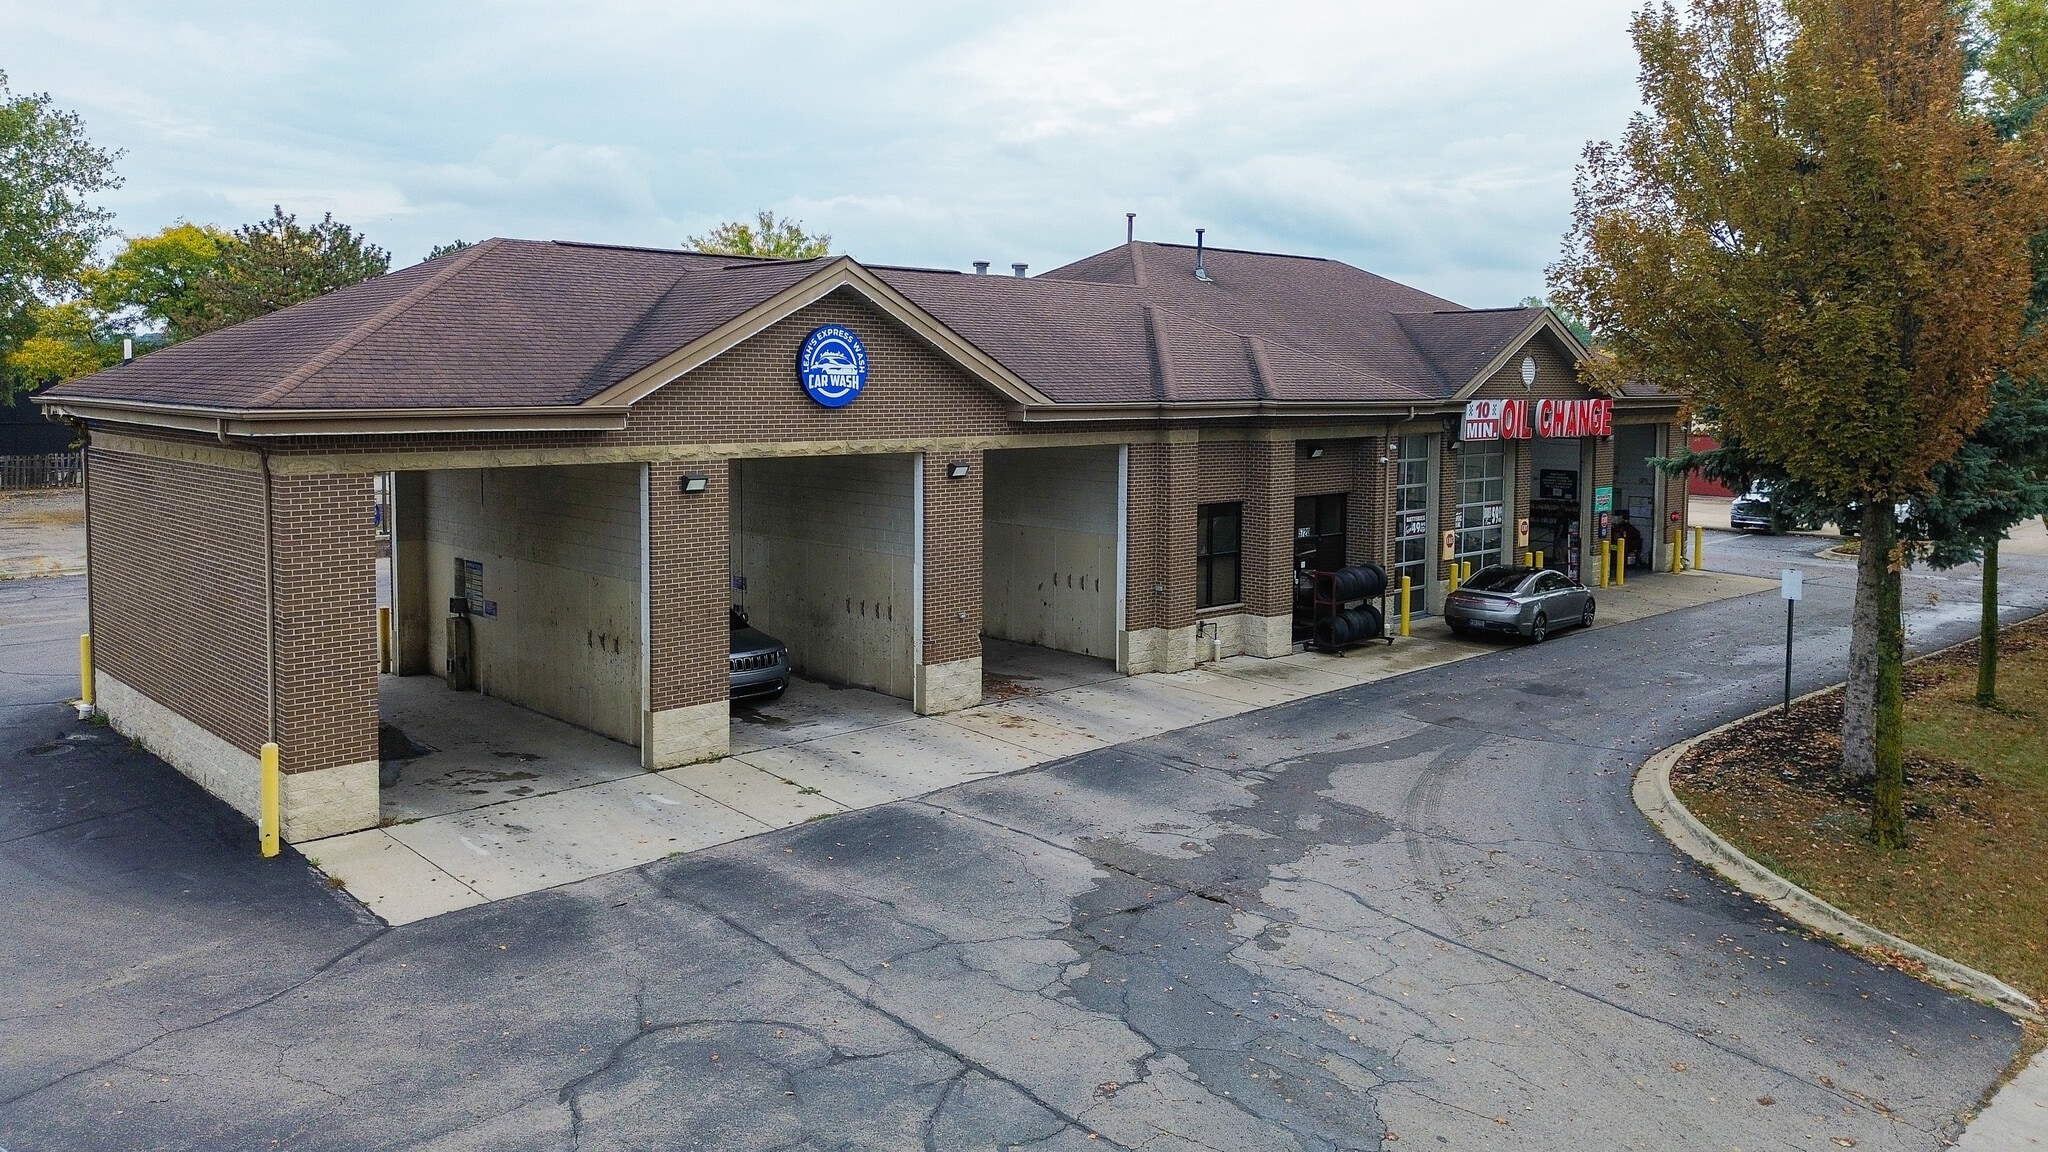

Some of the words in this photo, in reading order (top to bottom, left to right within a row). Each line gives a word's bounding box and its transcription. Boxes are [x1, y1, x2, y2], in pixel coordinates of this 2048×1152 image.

[803, 338, 817, 373] LEAH'S
[816, 328, 853, 343] EXPRESS
[853, 342, 865, 373] WASH
[808, 374, 828, 389] CAR
[829, 374, 859, 390] WASH
[1475, 401, 1491, 418] 10
[1500, 399, 1533, 440] OIL
[1536, 398, 1613, 438] CHANGE
[1466, 422, 1497, 439] MIN.
